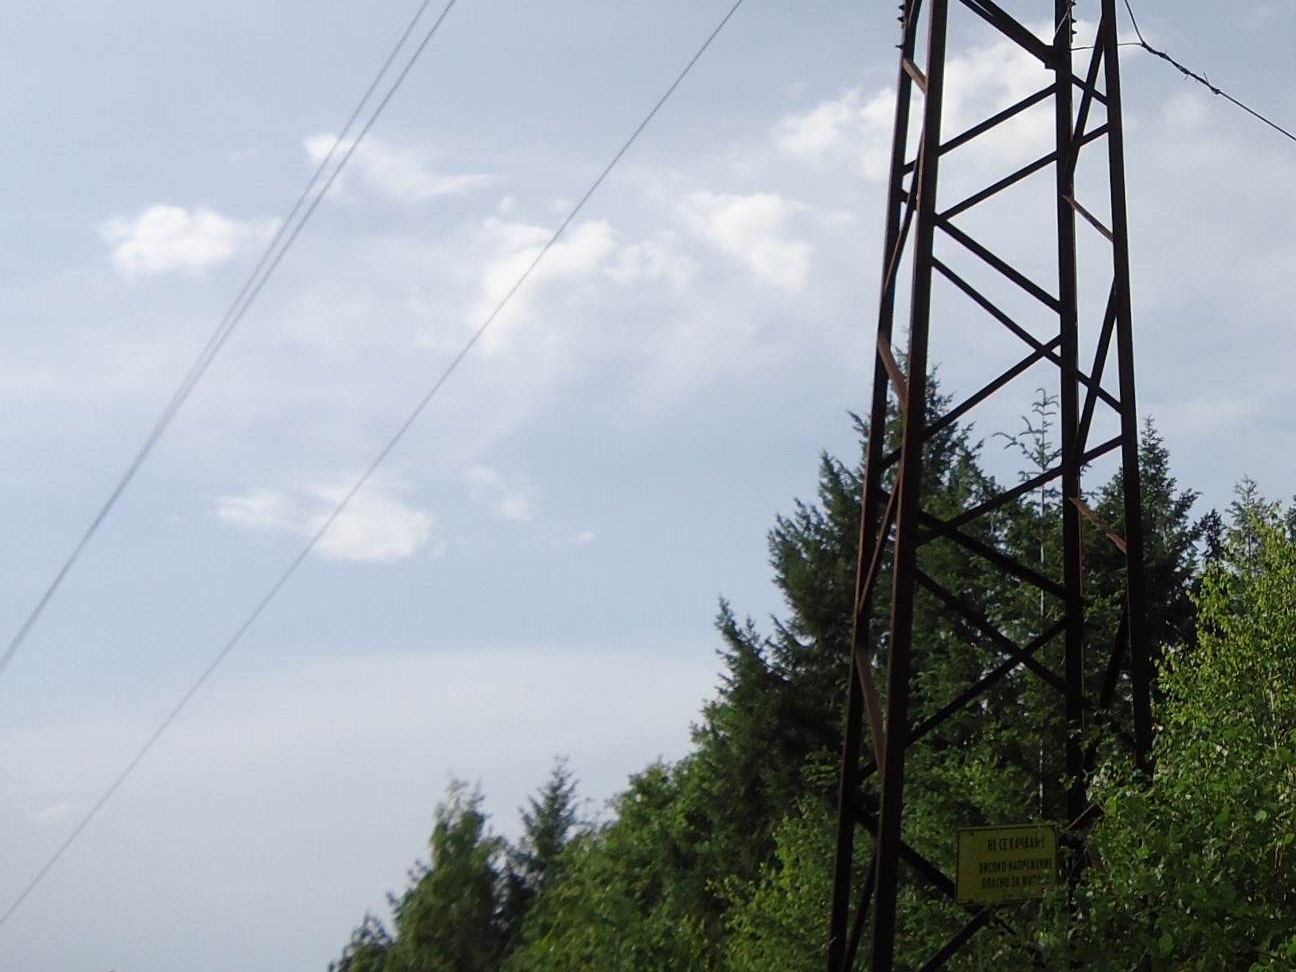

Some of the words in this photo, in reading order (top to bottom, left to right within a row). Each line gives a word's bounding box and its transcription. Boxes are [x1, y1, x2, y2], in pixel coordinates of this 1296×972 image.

[987, 838, 996, 851] НЕ
[999, 837, 1007, 850] СЕ
[979, 861, 1007, 873] ВИСОКО
[982, 877, 1009, 889] ОПАСНО
